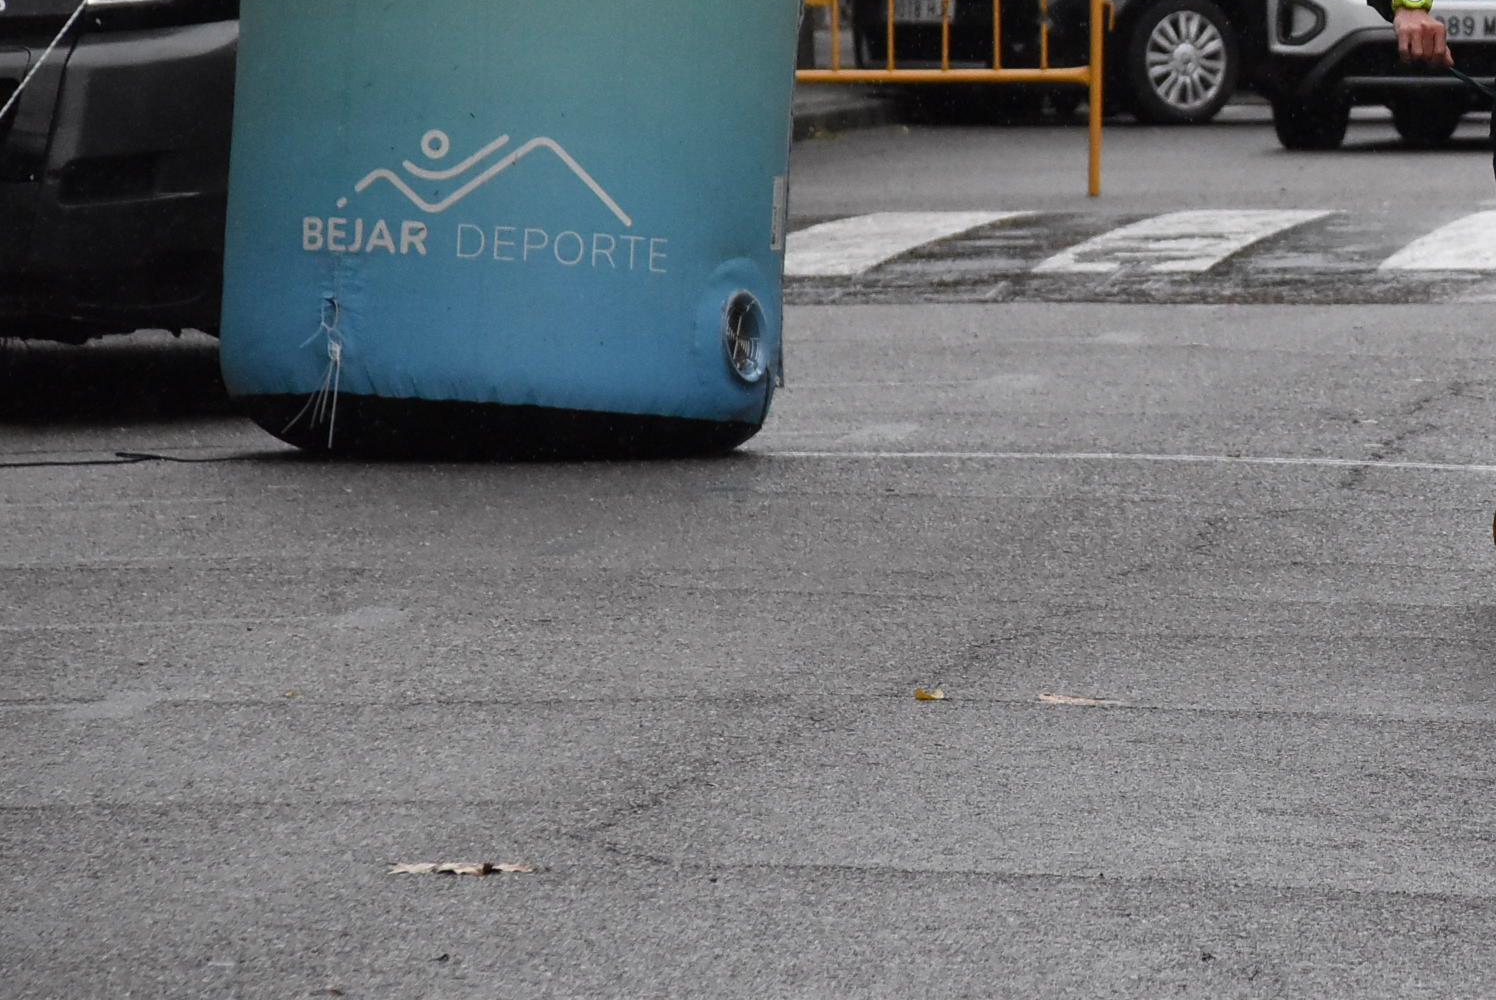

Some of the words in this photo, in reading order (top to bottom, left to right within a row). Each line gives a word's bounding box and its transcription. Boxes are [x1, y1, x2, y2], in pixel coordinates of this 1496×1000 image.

[1436, 15, 1475, 36] 89
[302, 197, 428, 256] BÉJAR
[456, 222, 668, 273] DEPORTE
